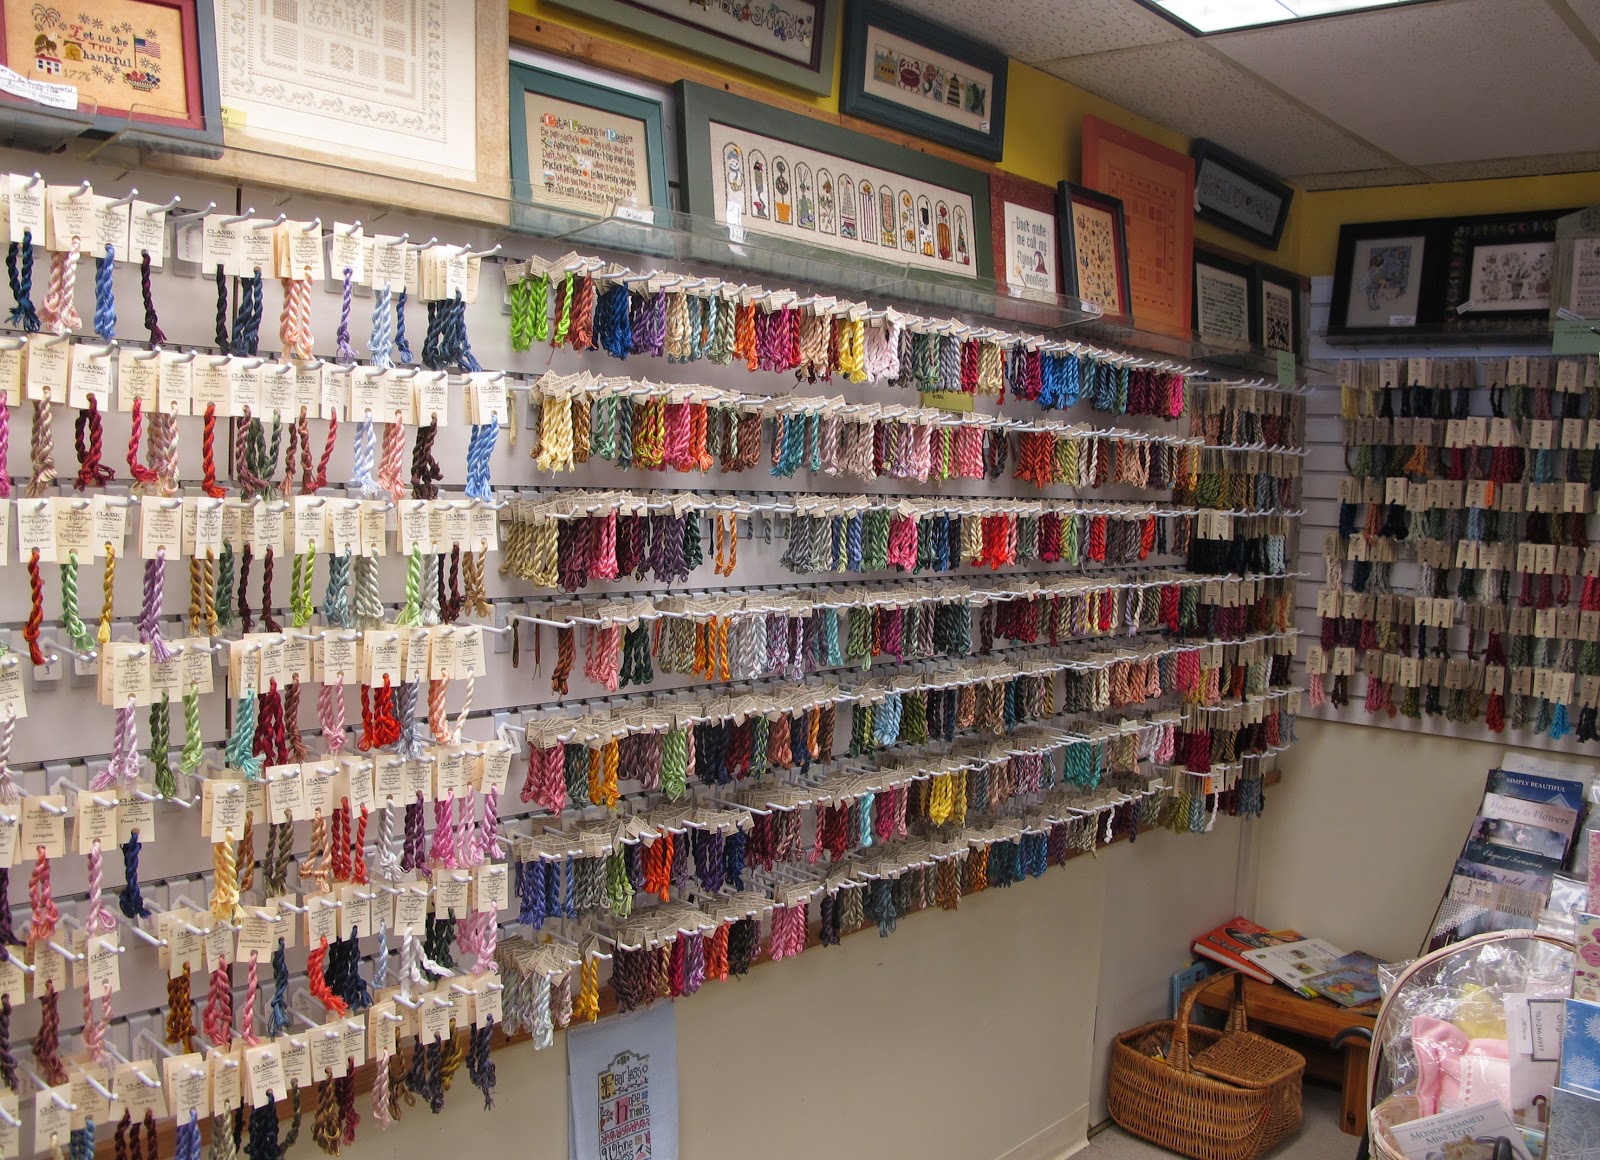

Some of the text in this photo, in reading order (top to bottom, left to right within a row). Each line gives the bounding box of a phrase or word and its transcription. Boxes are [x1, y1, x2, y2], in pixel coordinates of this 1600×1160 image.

[116, 37, 128, 47] be
[64, 68, 92, 82] 1776
[1039, 240, 1046, 256] my
[1506, 777, 1566, 792] SIMPLY BEAUTIFUL
[1490, 801, 1570, 825] Hearts & Flowers
[1496, 903, 1532, 918] HARDANGER
[253, 1060, 278, 1071] CLASSIC
[1409, 1114, 1485, 1141] MONOGRAMMED
[1426, 1126, 1476, 1146] MINI TOTE
